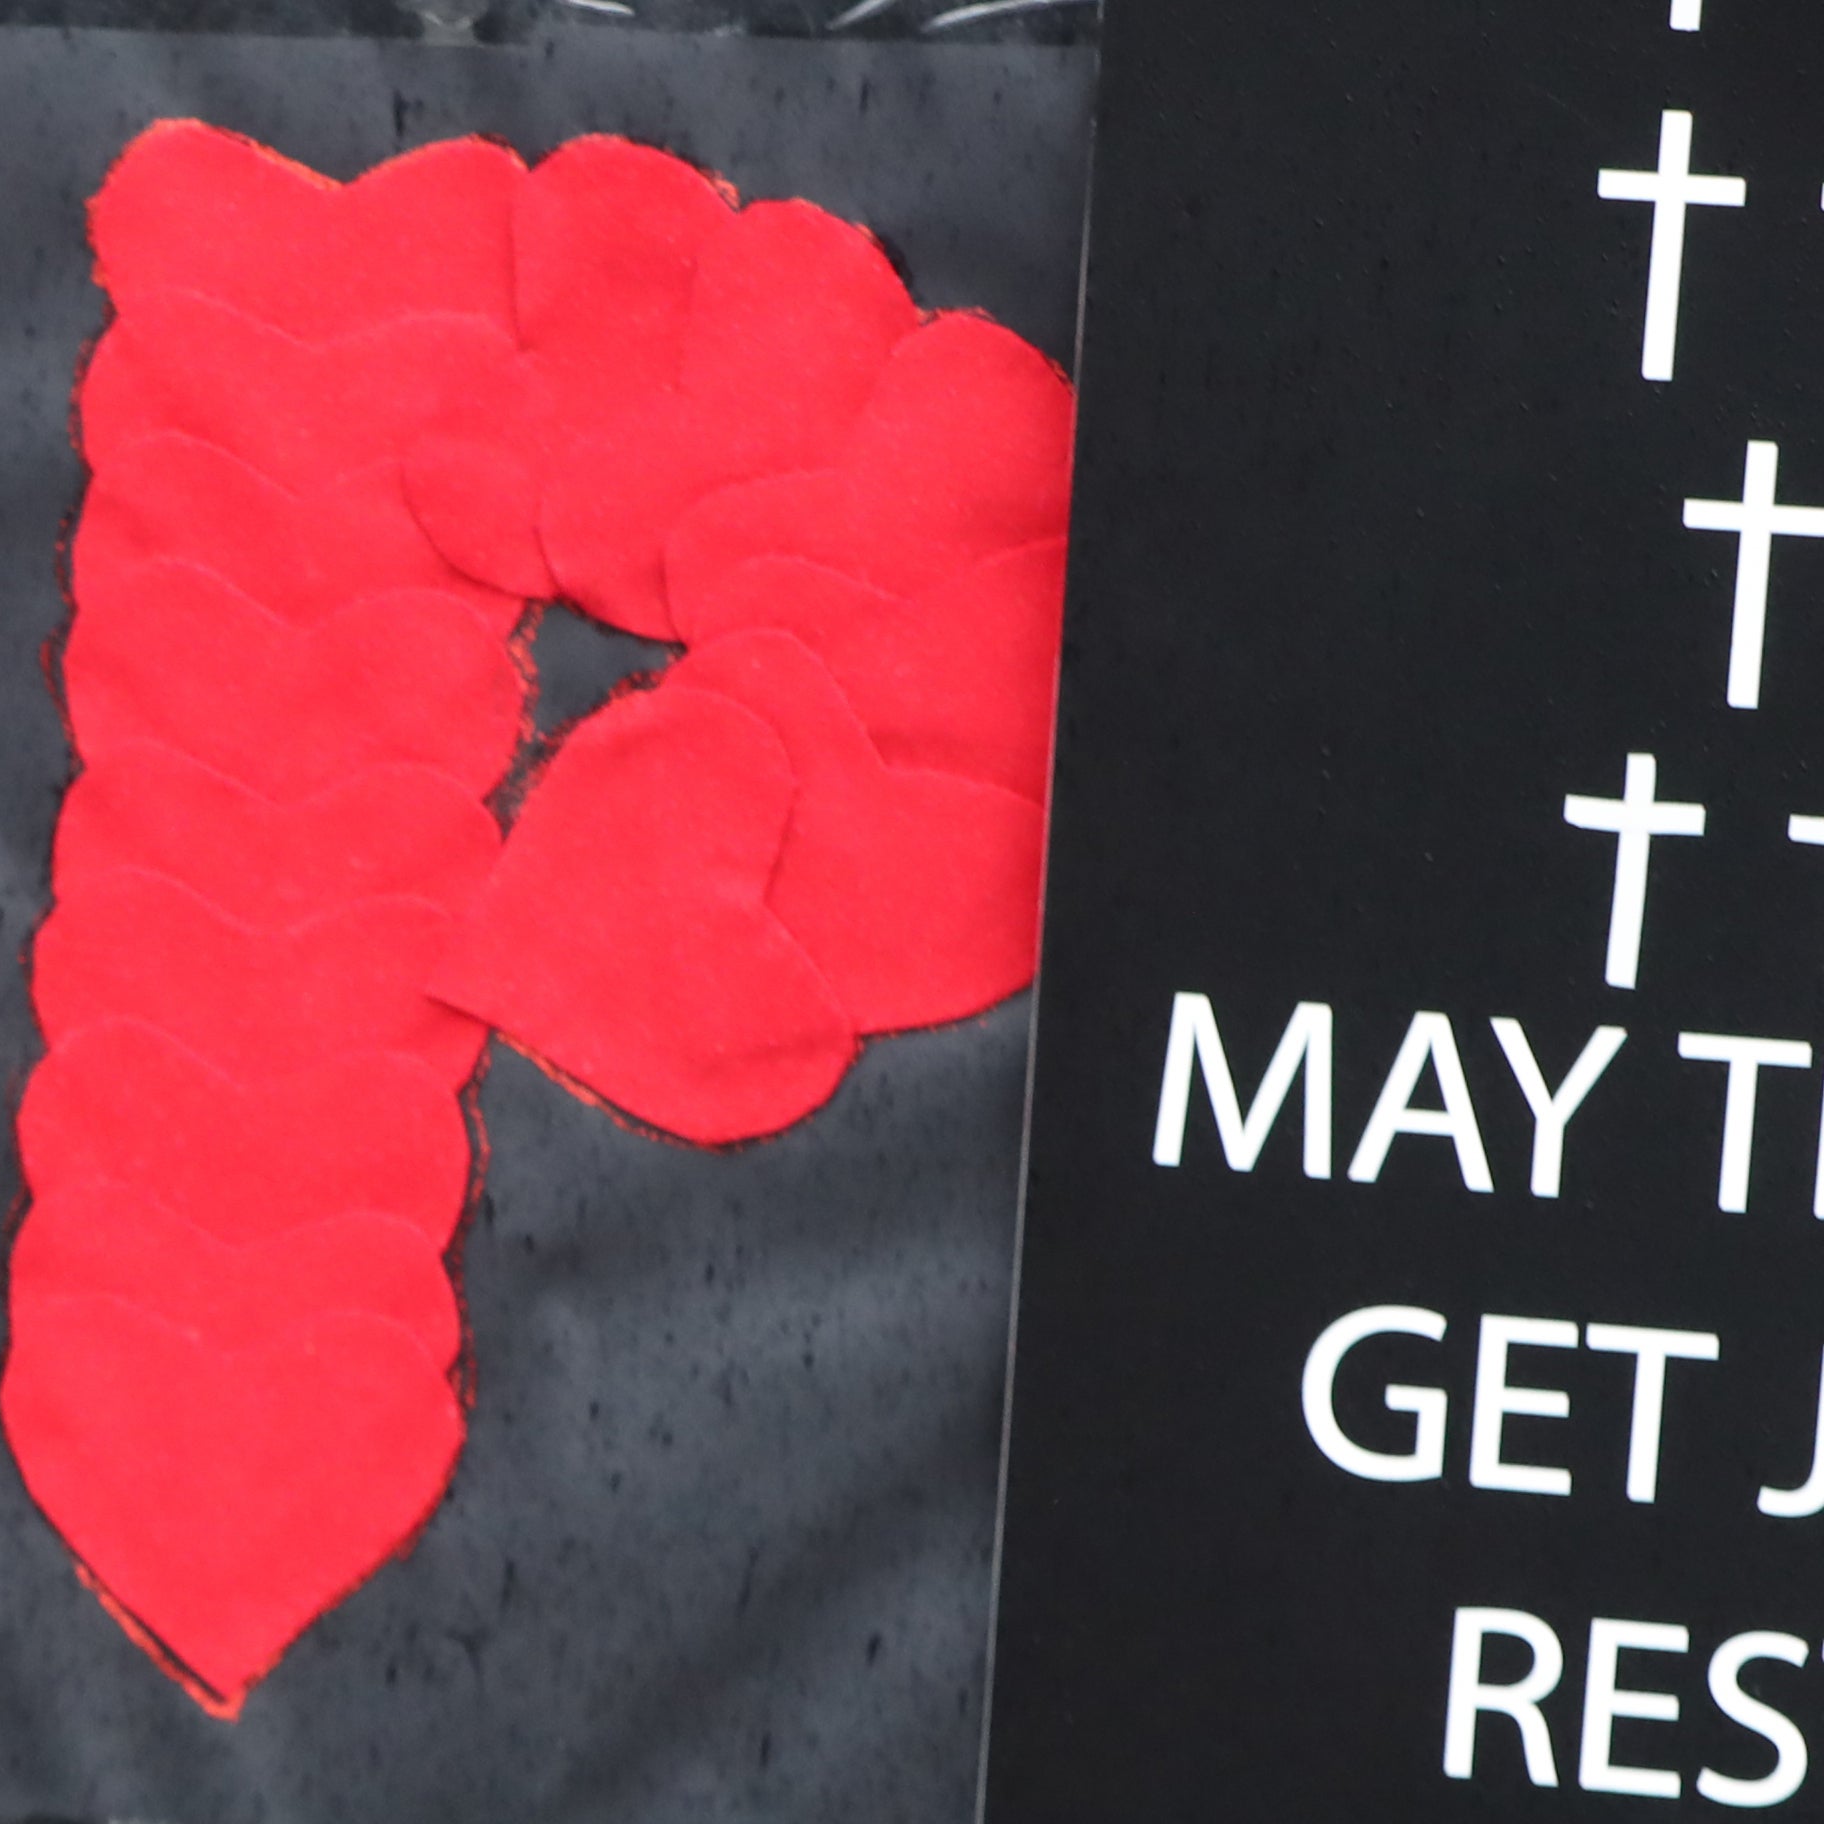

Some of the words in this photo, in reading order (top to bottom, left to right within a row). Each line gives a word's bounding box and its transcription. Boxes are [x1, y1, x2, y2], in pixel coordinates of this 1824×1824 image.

[1151, 990, 1629, 1200] MAY
[1676, 1030, 1824, 1221] T
[1300, 1303, 1721, 1504] GET
[1442, 1605, 1824, 1809] RES
